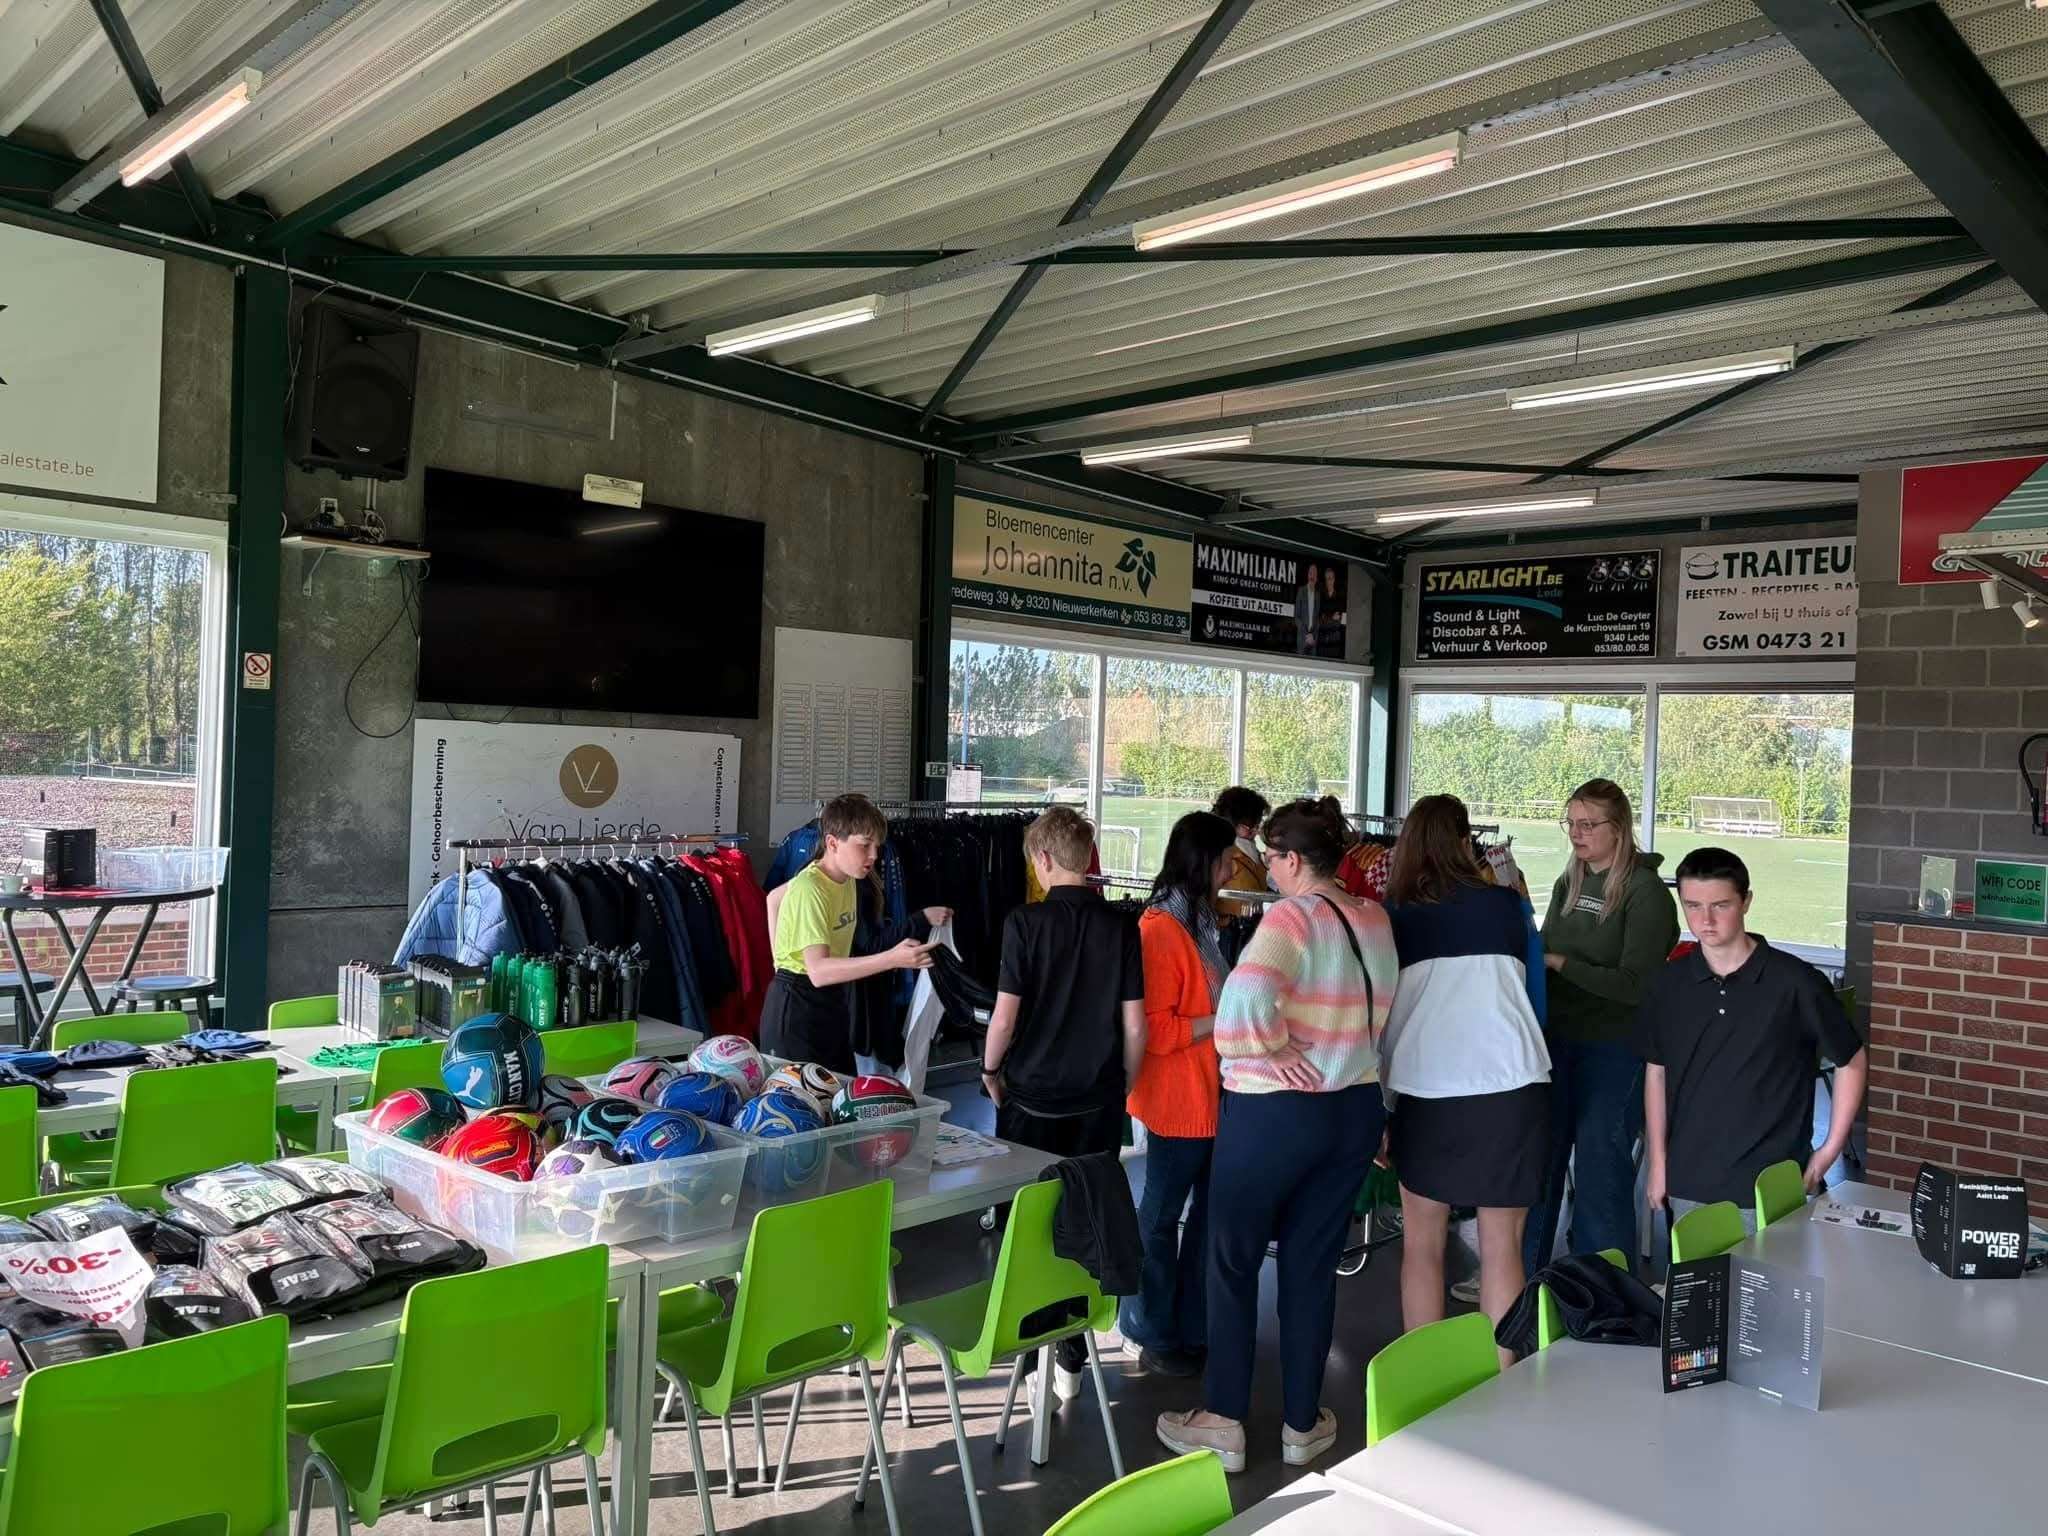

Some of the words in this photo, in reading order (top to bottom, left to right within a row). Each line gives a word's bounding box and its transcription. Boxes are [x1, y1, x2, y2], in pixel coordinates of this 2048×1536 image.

[986, 508, 1095, 546] Bloemencenter
[982, 535, 1103, 586] Johannita
[1109, 575, 1133, 592] n.v.
[1197, 543, 1297, 585] MAXIMILIAAN
[1723, 545, 1856, 579] TRAITEU
[1209, 592, 1240, 608] KOFFIE
[1241, 598, 1257, 610] UIT
[1257, 600, 1284, 614] AALST
[1686, 587, 1738, 600] FEESTEN
[996, 590, 1009, 605] 39
[1026, 594, 1050, 610] 9320
[1052, 598, 1119, 619] Nieuwerkerken
[1134, 610, 1149, 623] 053
[1151, 612, 1161, 625] 83
[1163, 614, 1174, 627] 82
[1433, 610, 1472, 623] Sound
[1476, 610, 1485, 621] &
[1488, 608, 1520, 623] Light
[1588, 613, 1604, 621] Luc
[1606, 612, 1619, 621] De
[1718, 608, 1758, 621] Zowel
[1763, 608, 1779, 622] bij
[1783, 607, 1793, 618] U
[1798, 605, 1831, 618] thuis
[1836, 604, 1851, 617] of
[1432, 625, 1487, 638] Discobar
[1489, 625, 1499, 636] &
[1502, 624, 1527, 636] P.A.
[1639, 622, 1651, 630] 19
[1431, 641, 1480, 653] Verhuur
[1482, 640, 1492, 651] &
[1495, 639, 1548, 653] Verkoop
[1604, 633, 1625, 642] 9340
[1627, 633, 1650, 641] Lede
[1702, 635, 1749, 650] GSM
[1756, 633, 1812, 649] 0473
[1820, 631, 1845, 648] 21
[715, 747, 725, 818] Contactlenzen
[432, 738, 447, 862] Gehoorbescherming
[508, 818, 567, 840] Van
[2007, 878, 2041, 891] CODE
[503, 1050, 523, 1083] MAN
[1961, 1229, 2020, 1246] POWER
[1987, 1245, 2019, 1258] ADE
[8, 1248, 122, 1275] -30%
[276, 1268, 320, 1291] REAL
[174, 1305, 221, 1315] REAL
